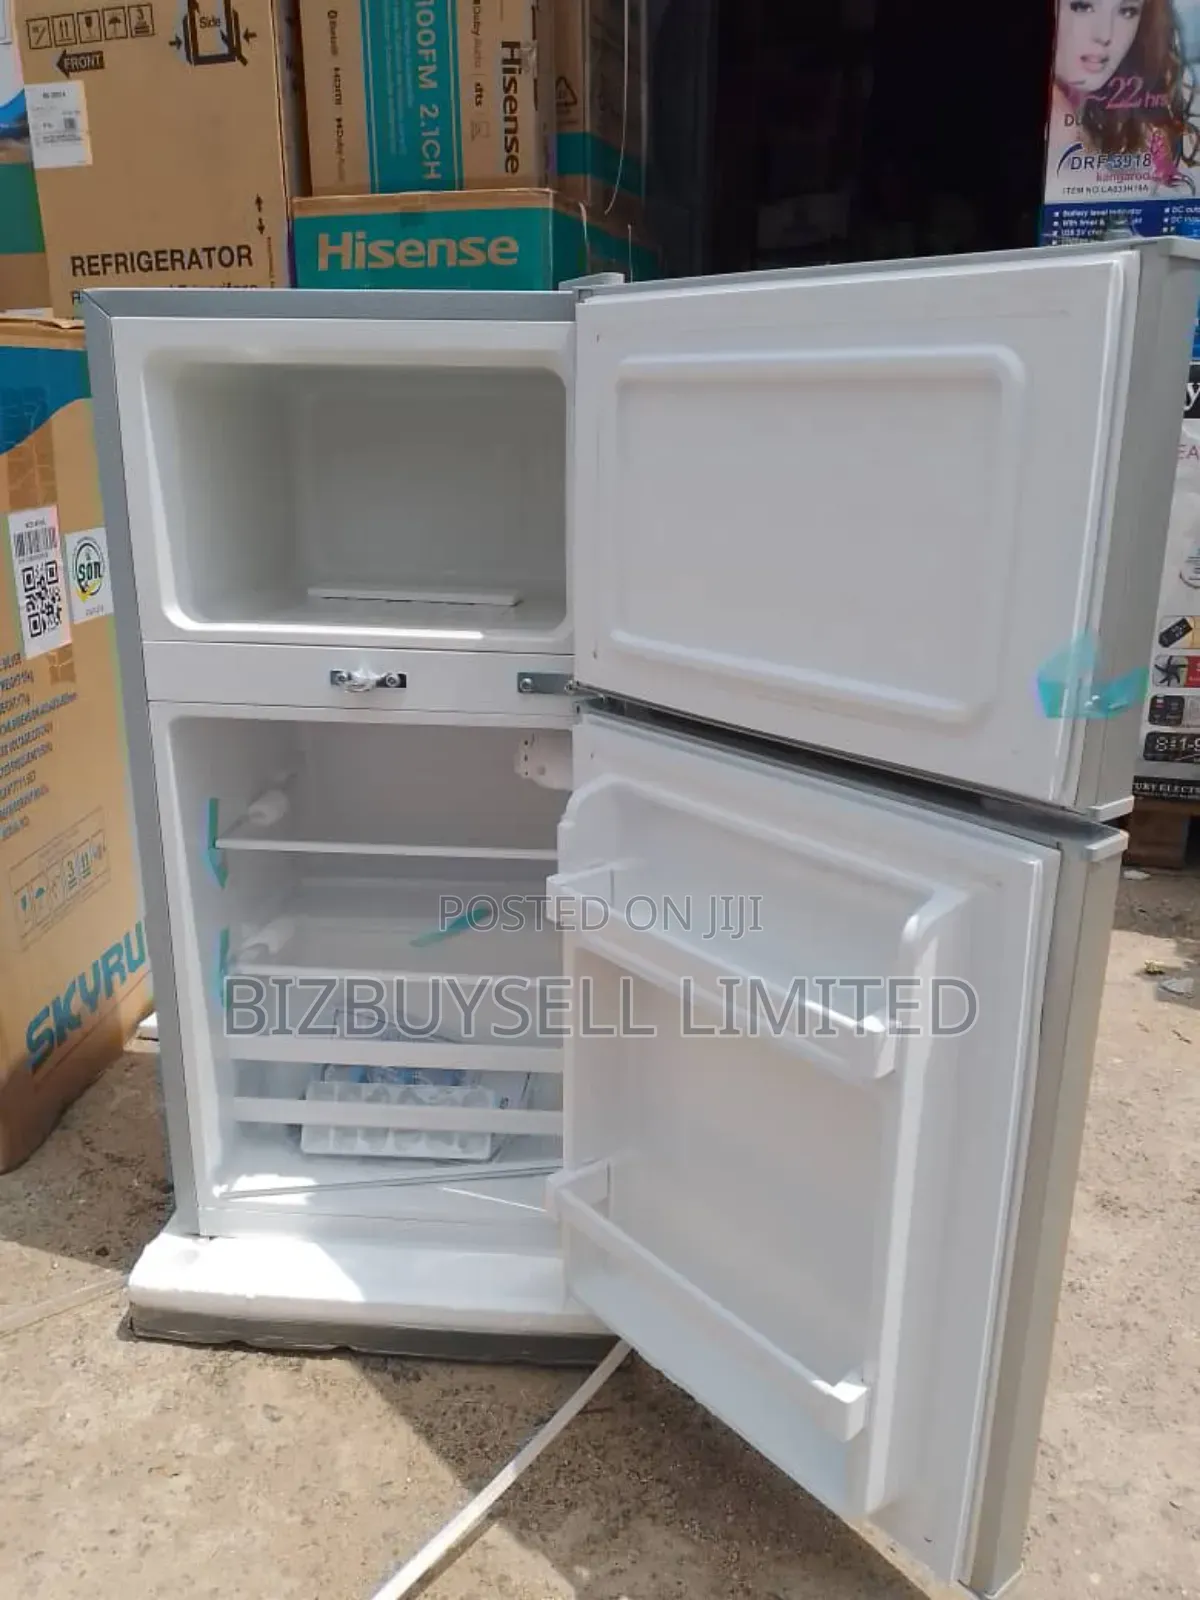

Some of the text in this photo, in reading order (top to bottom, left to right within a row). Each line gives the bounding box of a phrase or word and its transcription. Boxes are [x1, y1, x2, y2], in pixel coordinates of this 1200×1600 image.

[199, 16, 222, 28] Side
[63, 54, 102, 70] FRONT
[501, 40, 522, 174] Hisense
[418, 103, 442, 180] 2.1CH
[1070, 152, 1151, 171] DRF-3918
[70, 244, 254, 277] REFRIGERATOR
[317, 230, 519, 271] Hisense
